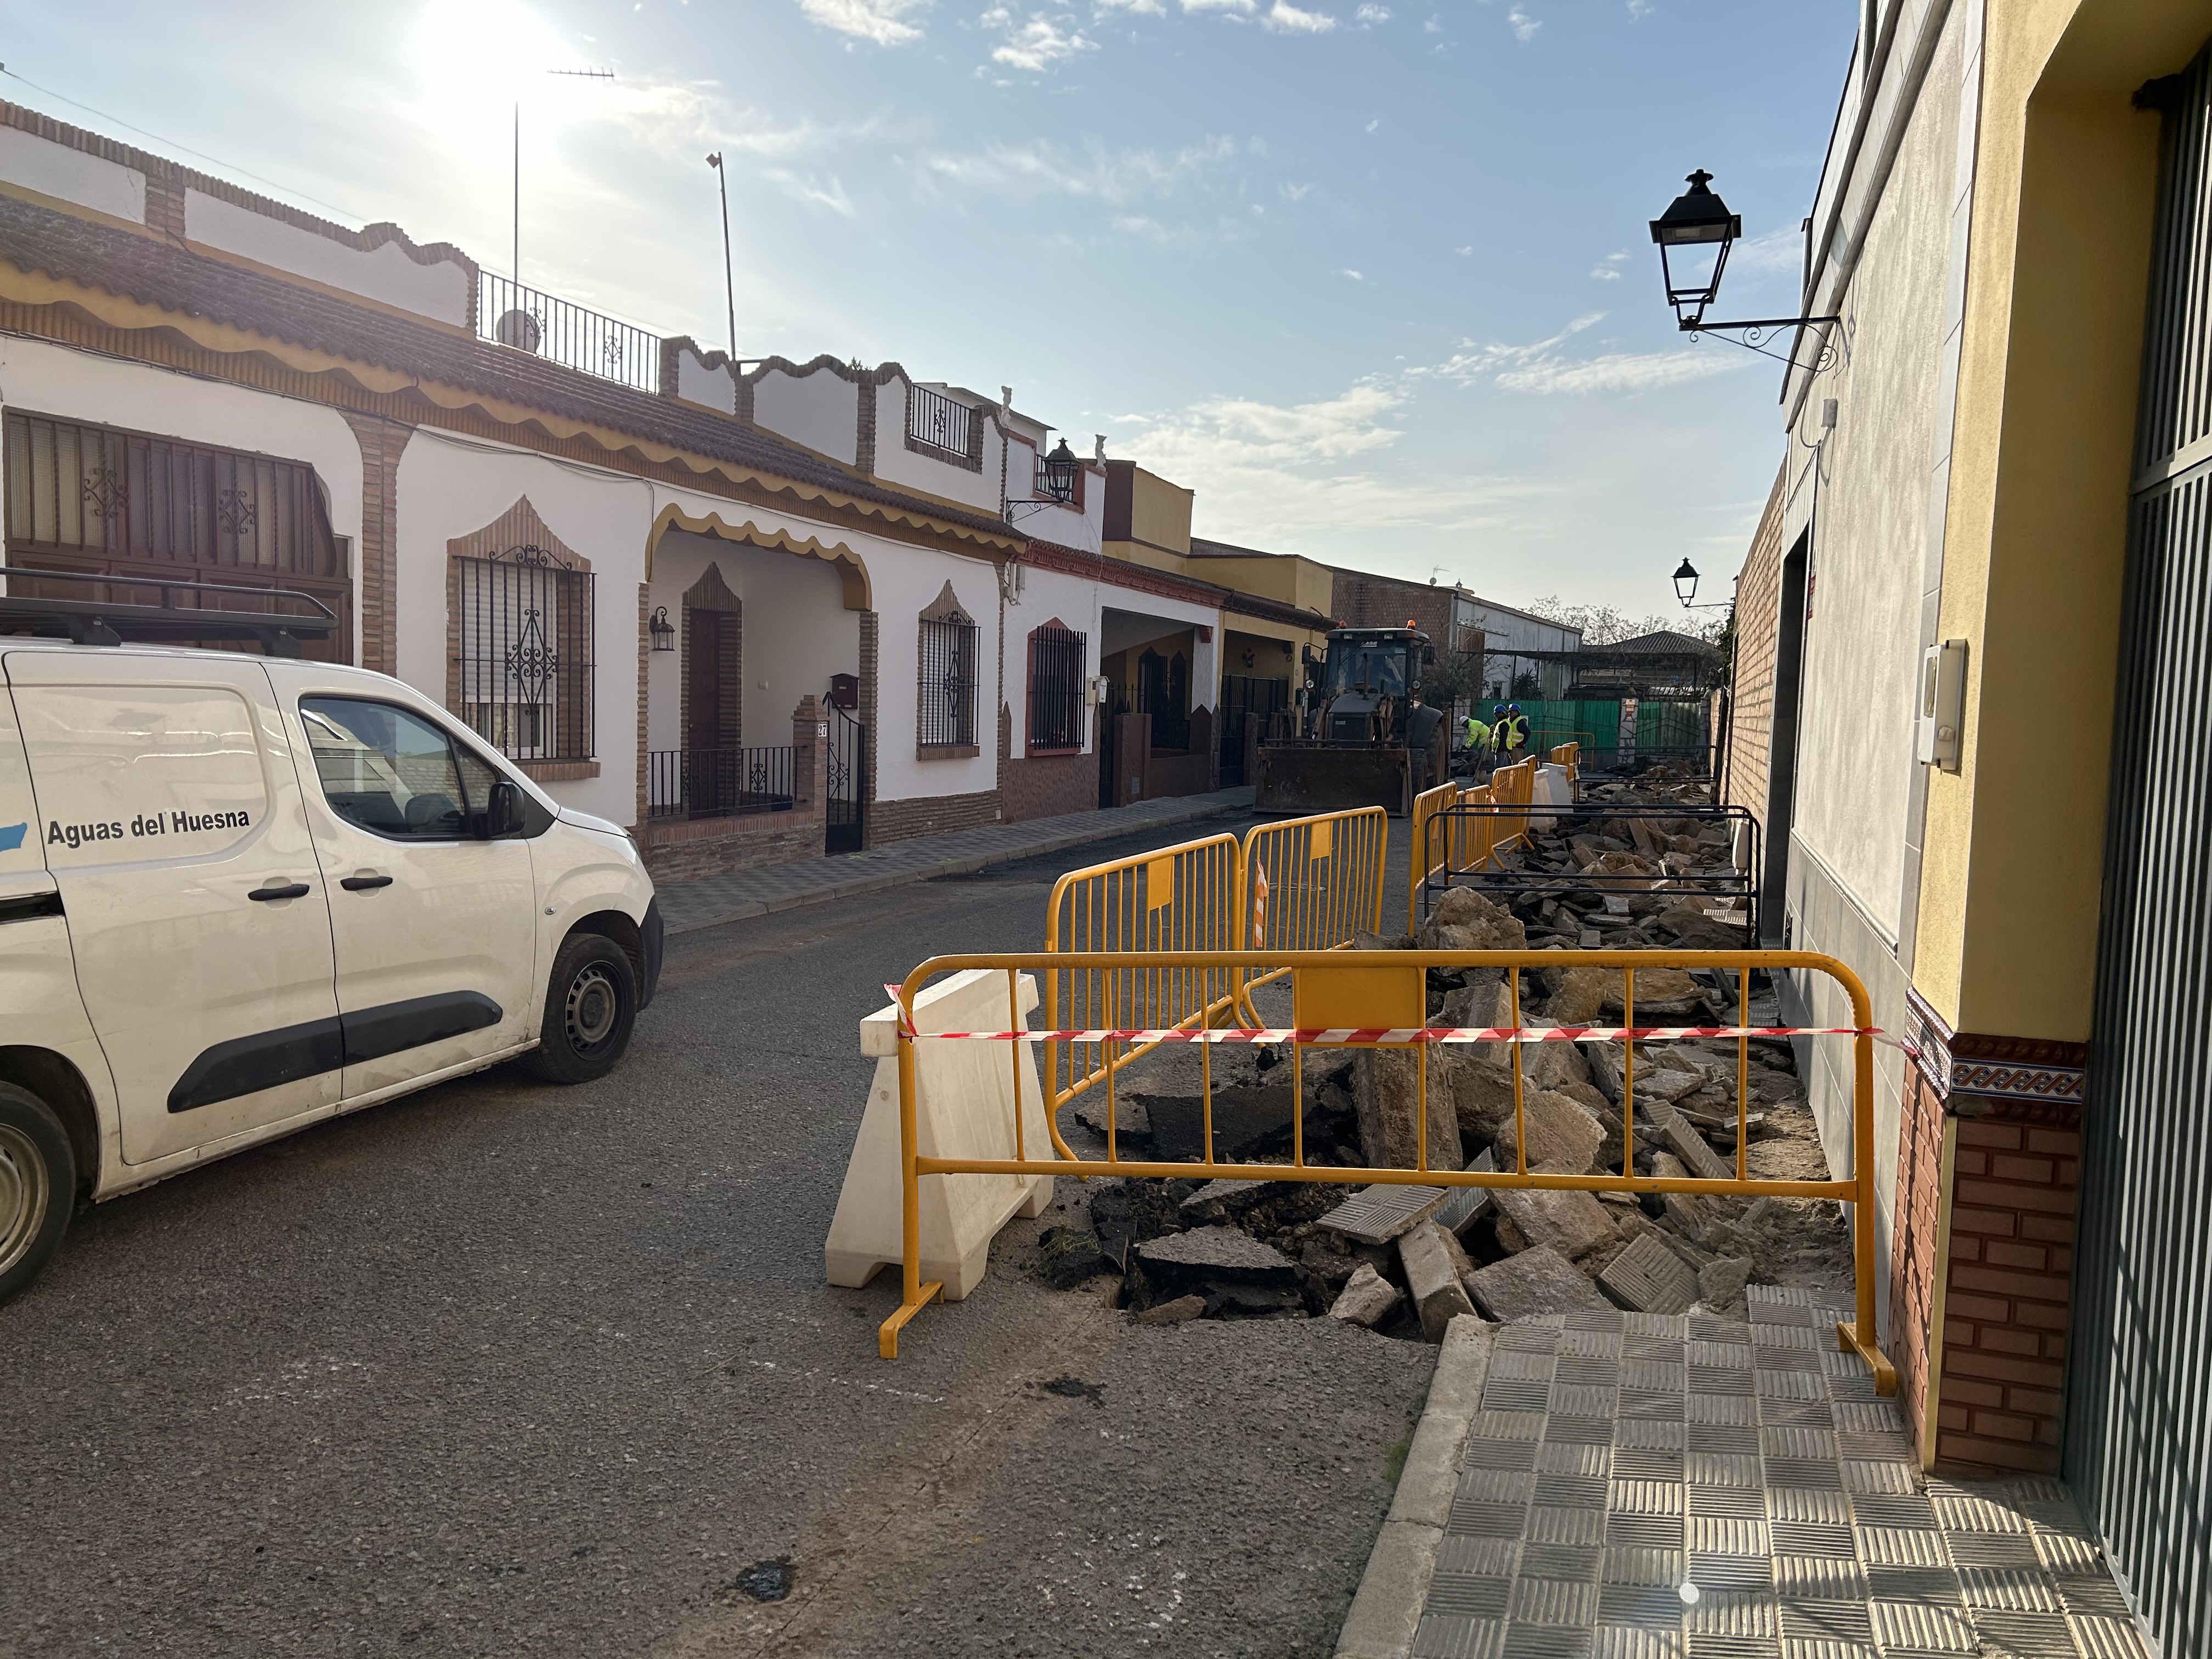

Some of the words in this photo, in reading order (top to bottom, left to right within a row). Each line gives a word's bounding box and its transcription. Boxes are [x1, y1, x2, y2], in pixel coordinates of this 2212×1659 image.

[819, 725, 826, 736] 27
[48, 821, 124, 849] Aguas
[131, 812, 165, 837] del
[171, 811, 250, 833] Huesna
